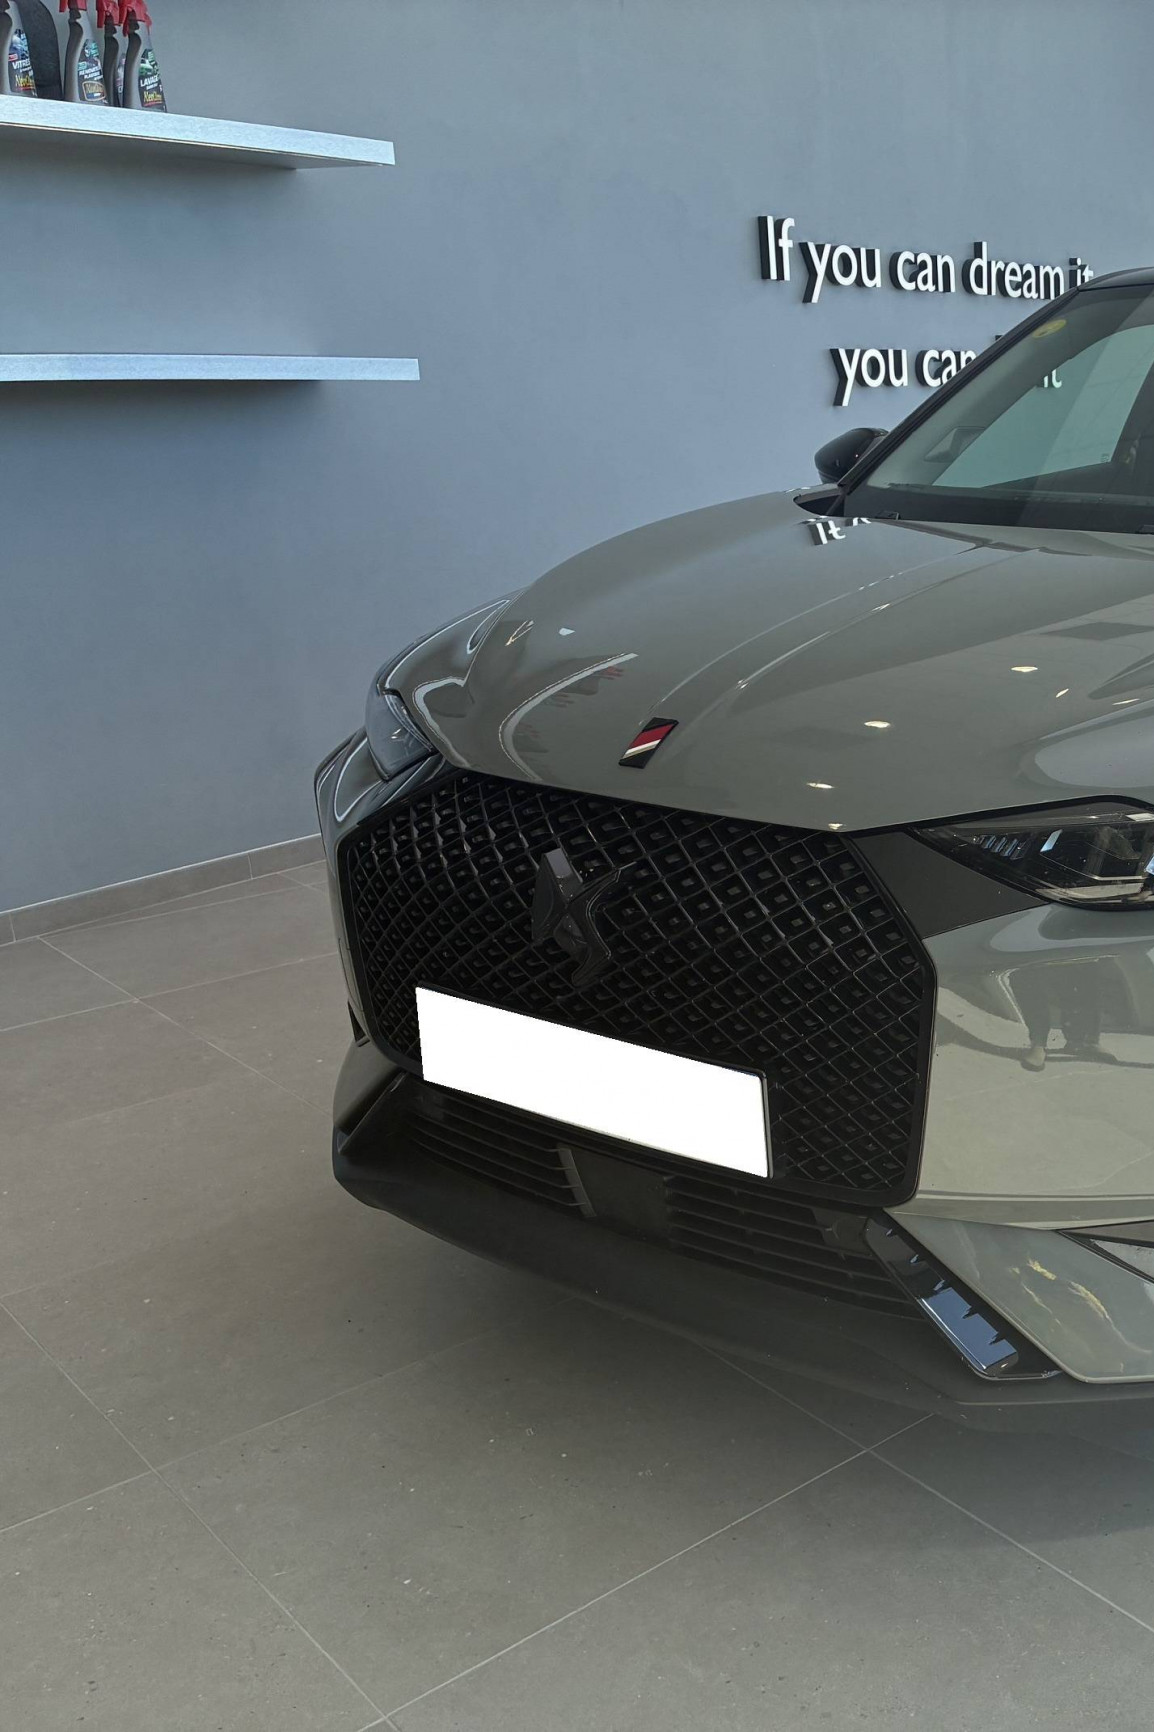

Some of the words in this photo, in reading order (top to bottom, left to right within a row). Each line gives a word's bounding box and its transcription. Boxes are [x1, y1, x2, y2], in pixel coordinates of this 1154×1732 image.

[757, 215, 795, 281] If
[800, 241, 882, 303] you
[889, 250, 956, 293] can
[961, 241, 1065, 300] dream
[829, 347, 909, 406] you
